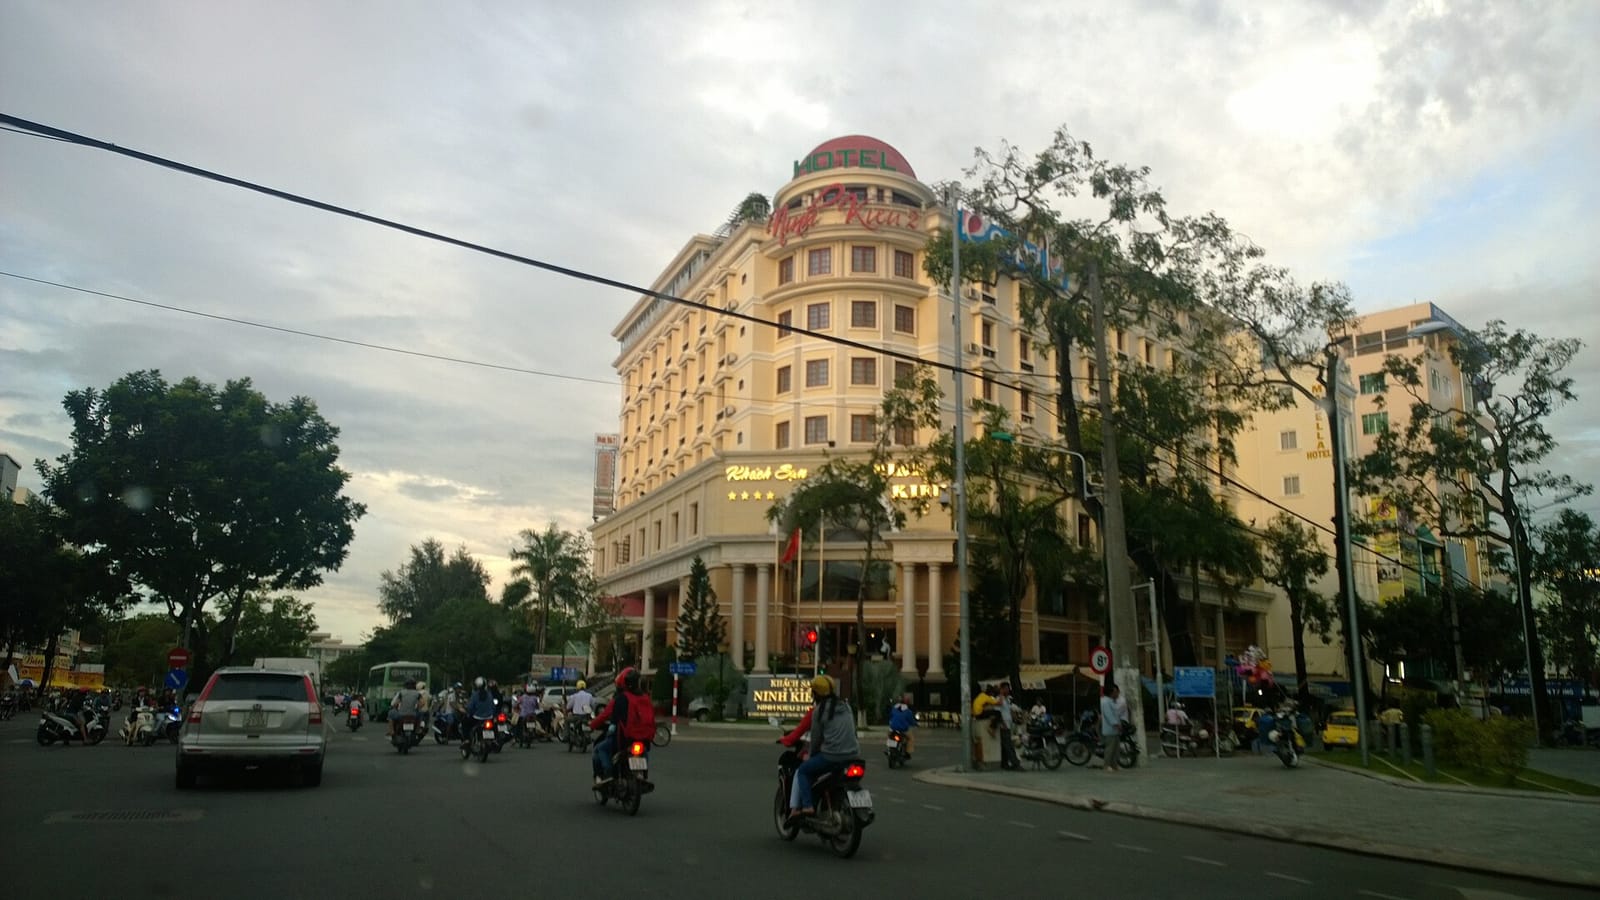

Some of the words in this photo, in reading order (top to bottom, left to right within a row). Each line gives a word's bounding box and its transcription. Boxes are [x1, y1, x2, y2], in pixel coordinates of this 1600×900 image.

[793, 149, 896, 179] HOTEL
[907, 207, 919, 230] 2
[1306, 449, 1331, 460] HOTEL
[753, 690, 788, 702] NINH
